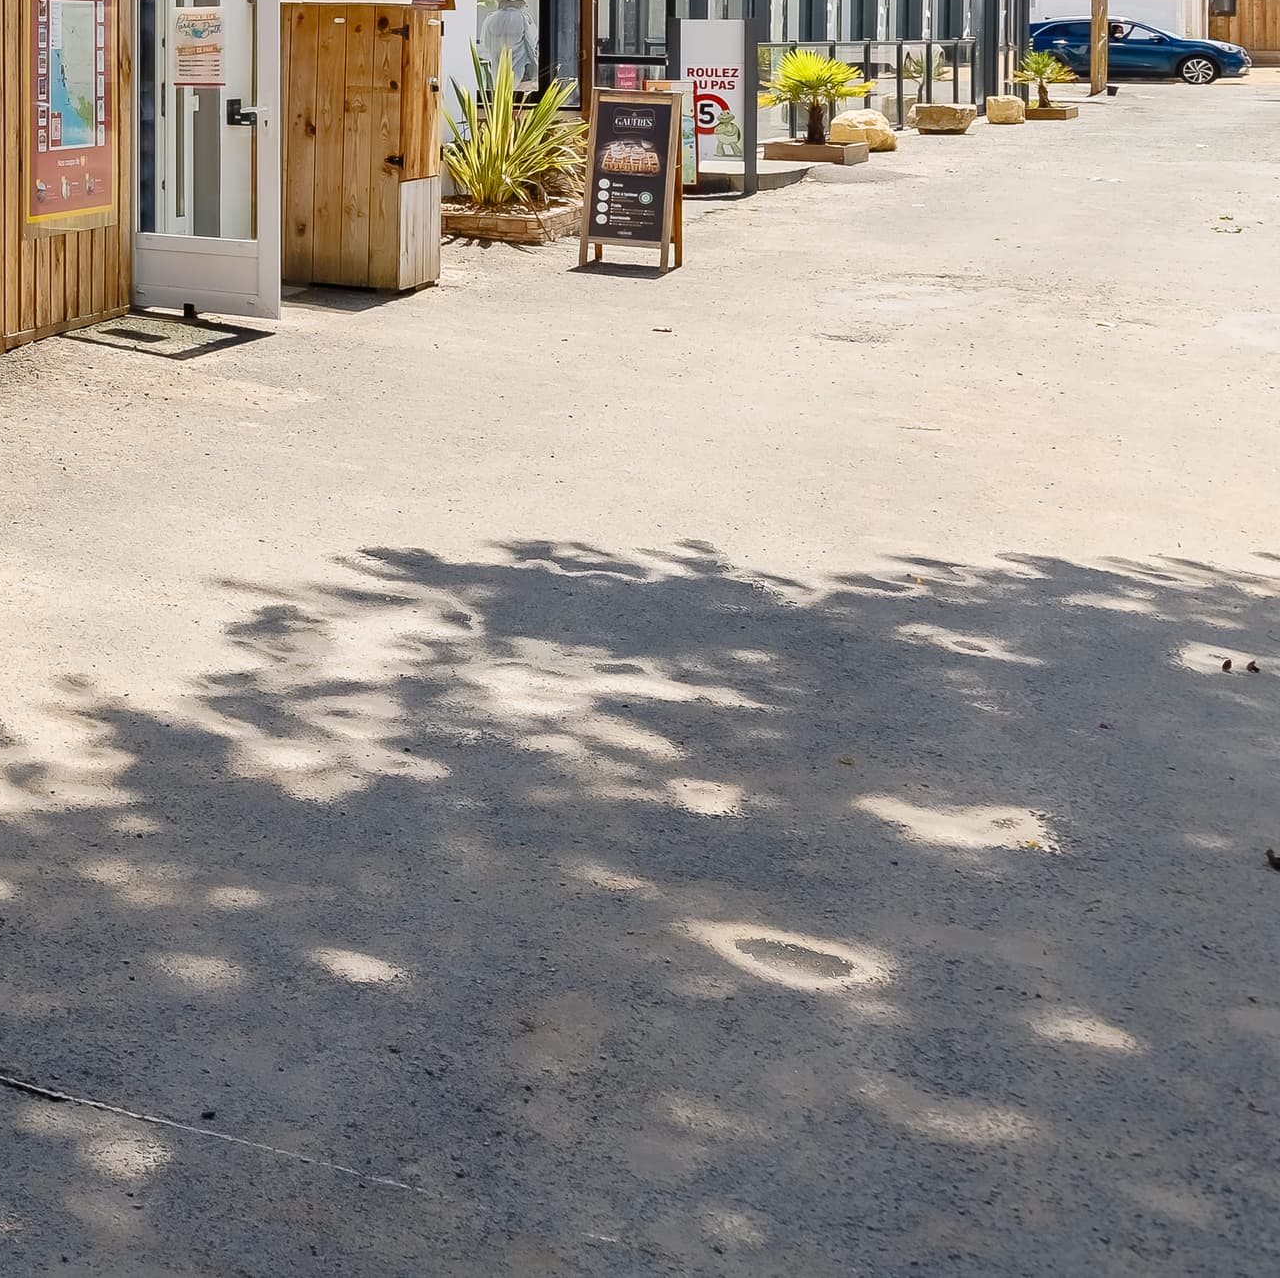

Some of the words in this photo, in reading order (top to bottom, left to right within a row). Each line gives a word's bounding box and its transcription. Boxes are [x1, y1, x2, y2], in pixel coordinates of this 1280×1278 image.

[687, 67, 739, 78] ROULEZ
[697, 80, 708, 90] U
[711, 80, 735, 90] PAS
[699, 103, 715, 124] 5
